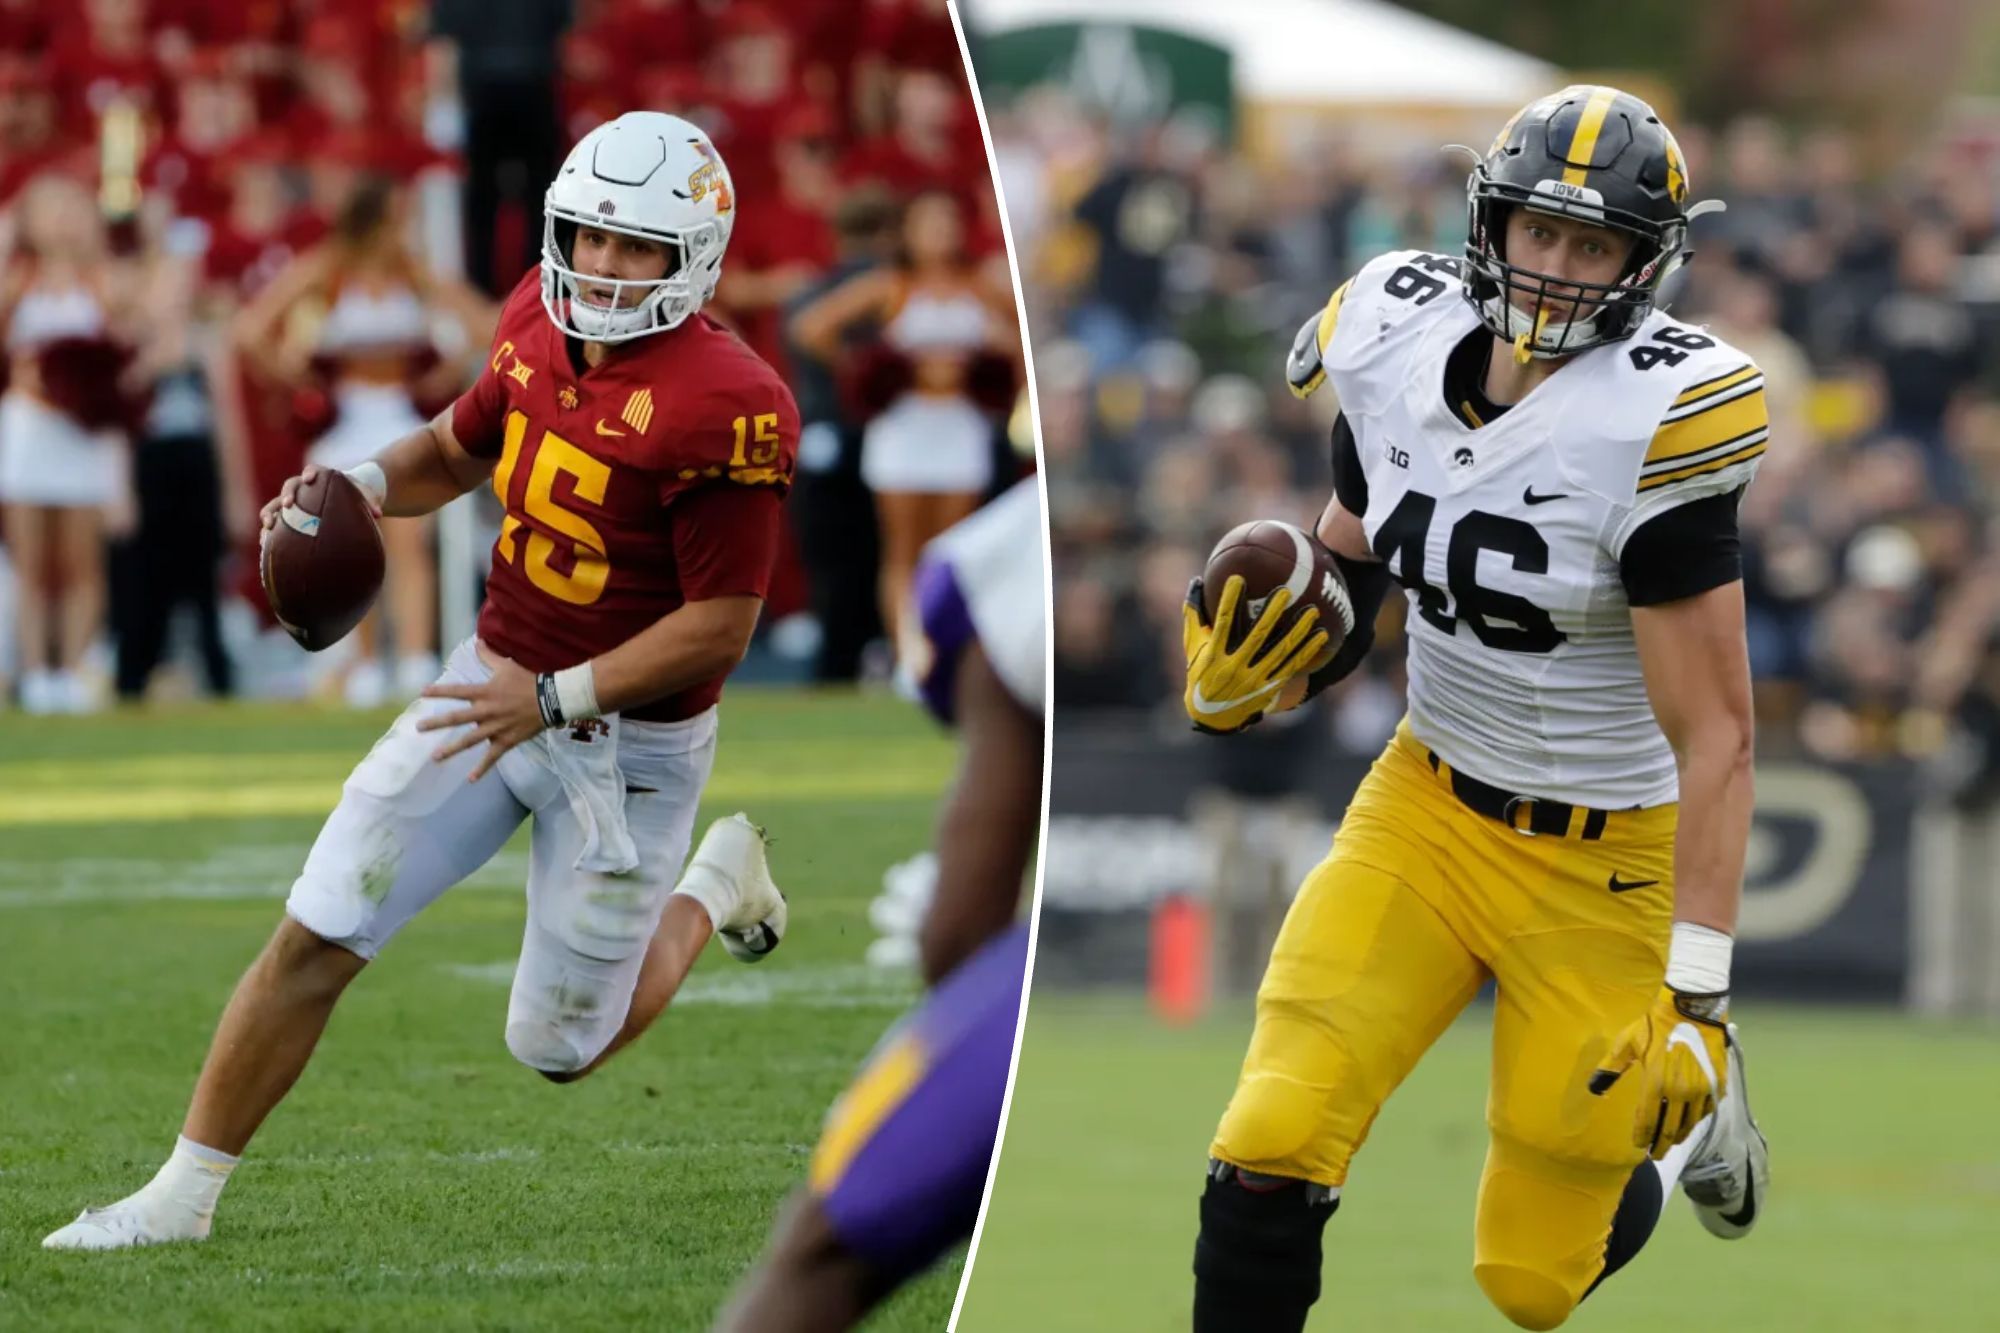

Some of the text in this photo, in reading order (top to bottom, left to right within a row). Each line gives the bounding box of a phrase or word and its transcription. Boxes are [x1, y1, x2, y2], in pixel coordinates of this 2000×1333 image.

[1552, 183, 1584, 200] IOWA
[1628, 326, 1716, 371] 46
[729, 413, 779, 466] 15
[492, 410, 612, 605] 15
[1372, 489, 1567, 654] 46
